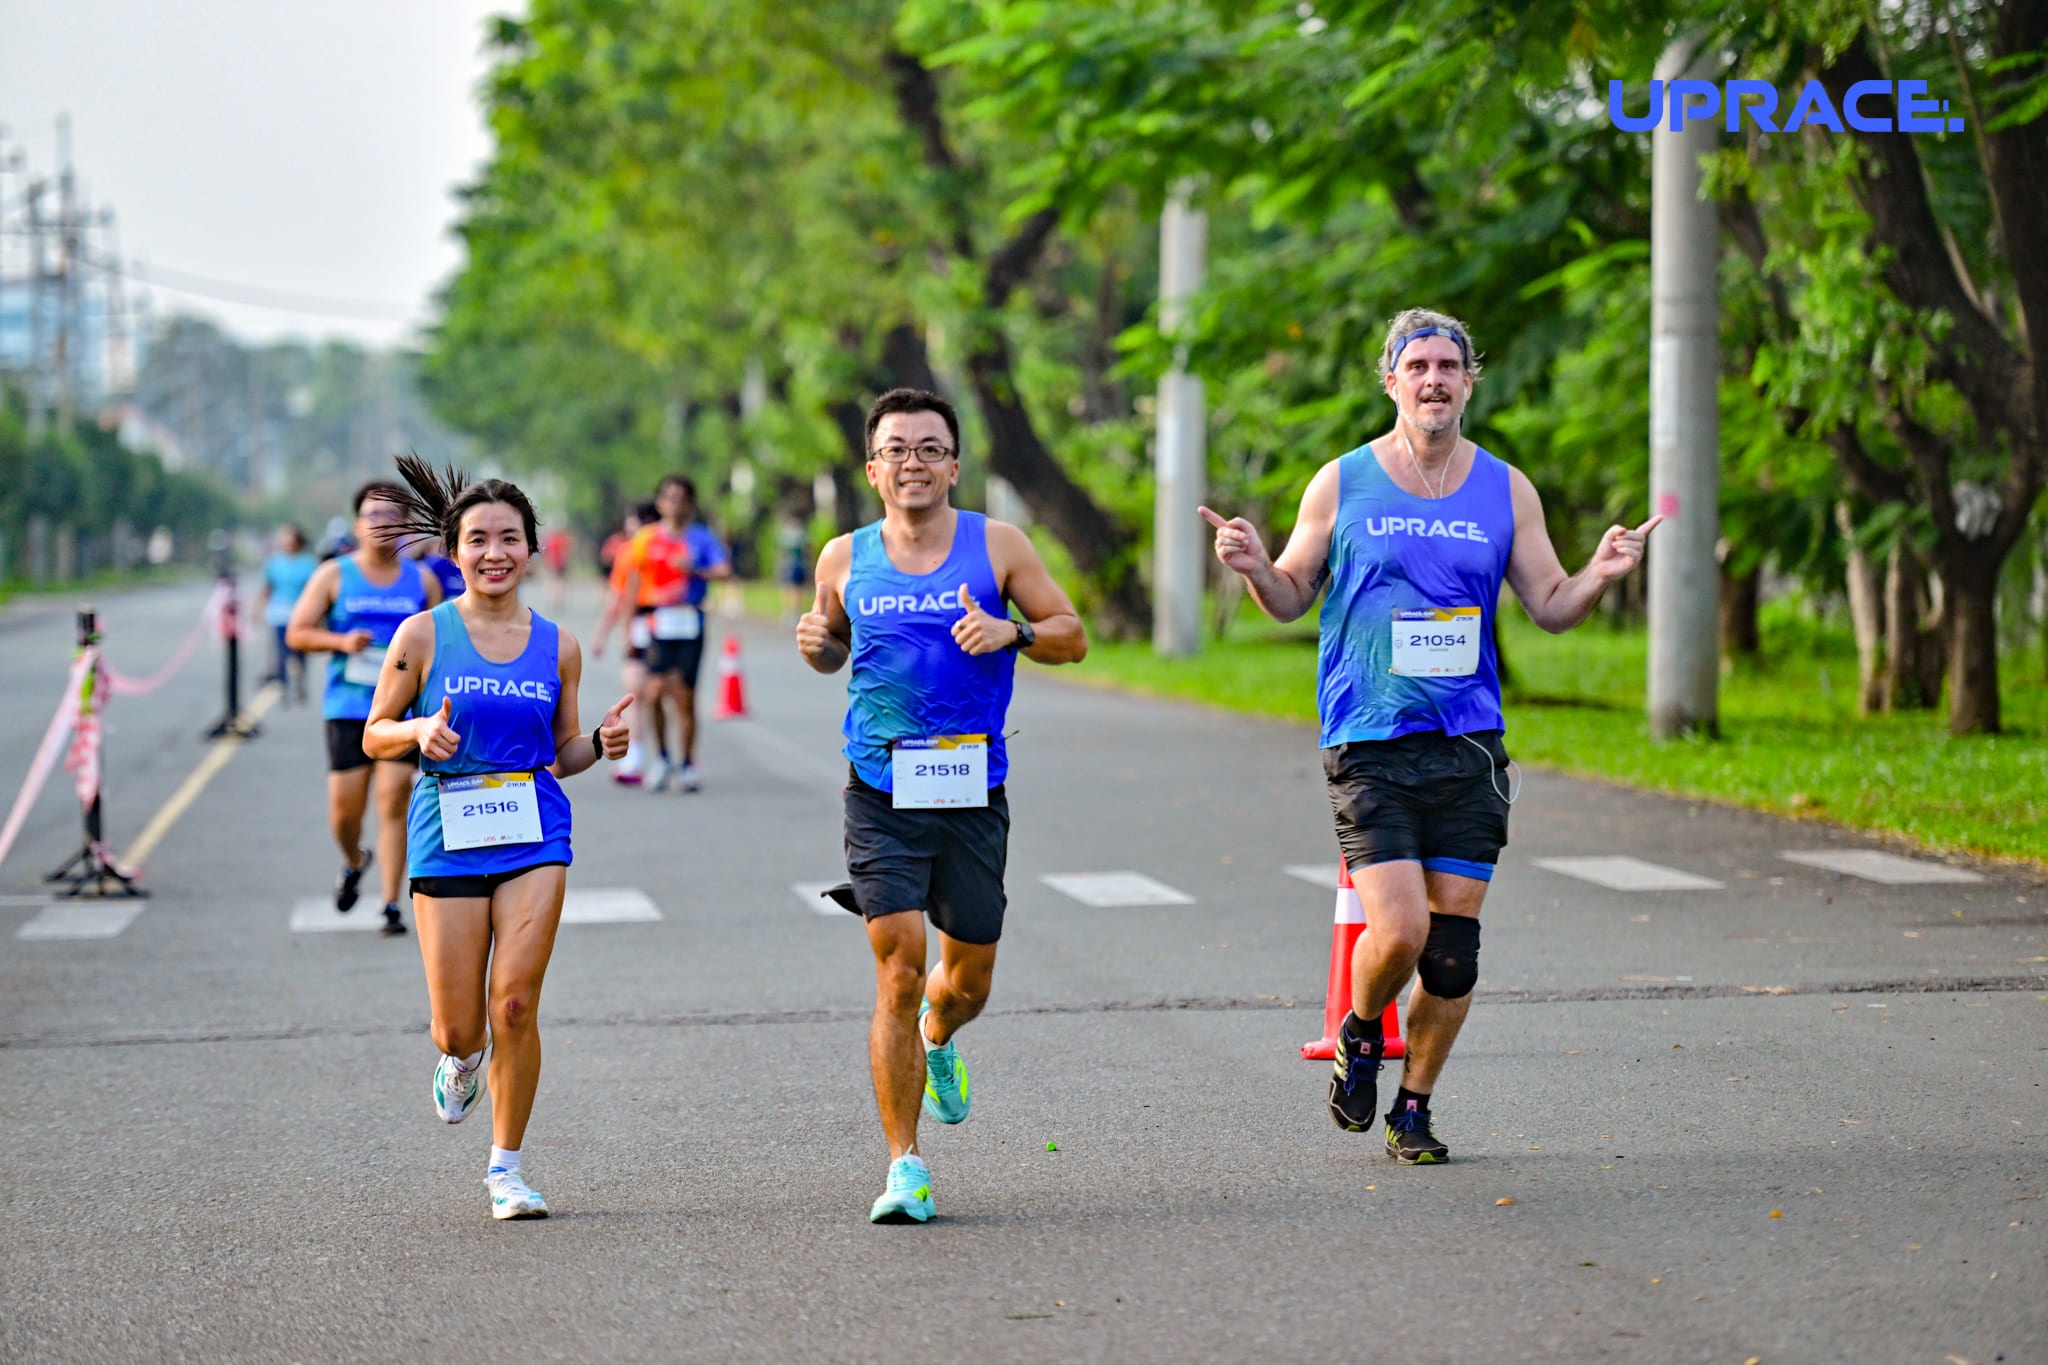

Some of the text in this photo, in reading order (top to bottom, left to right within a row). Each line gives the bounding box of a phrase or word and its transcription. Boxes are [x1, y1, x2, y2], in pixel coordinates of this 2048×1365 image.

[1410, 634, 1466, 646] 21054
[914, 763, 970, 776] 21518
[462, 800, 519, 817] 21516
